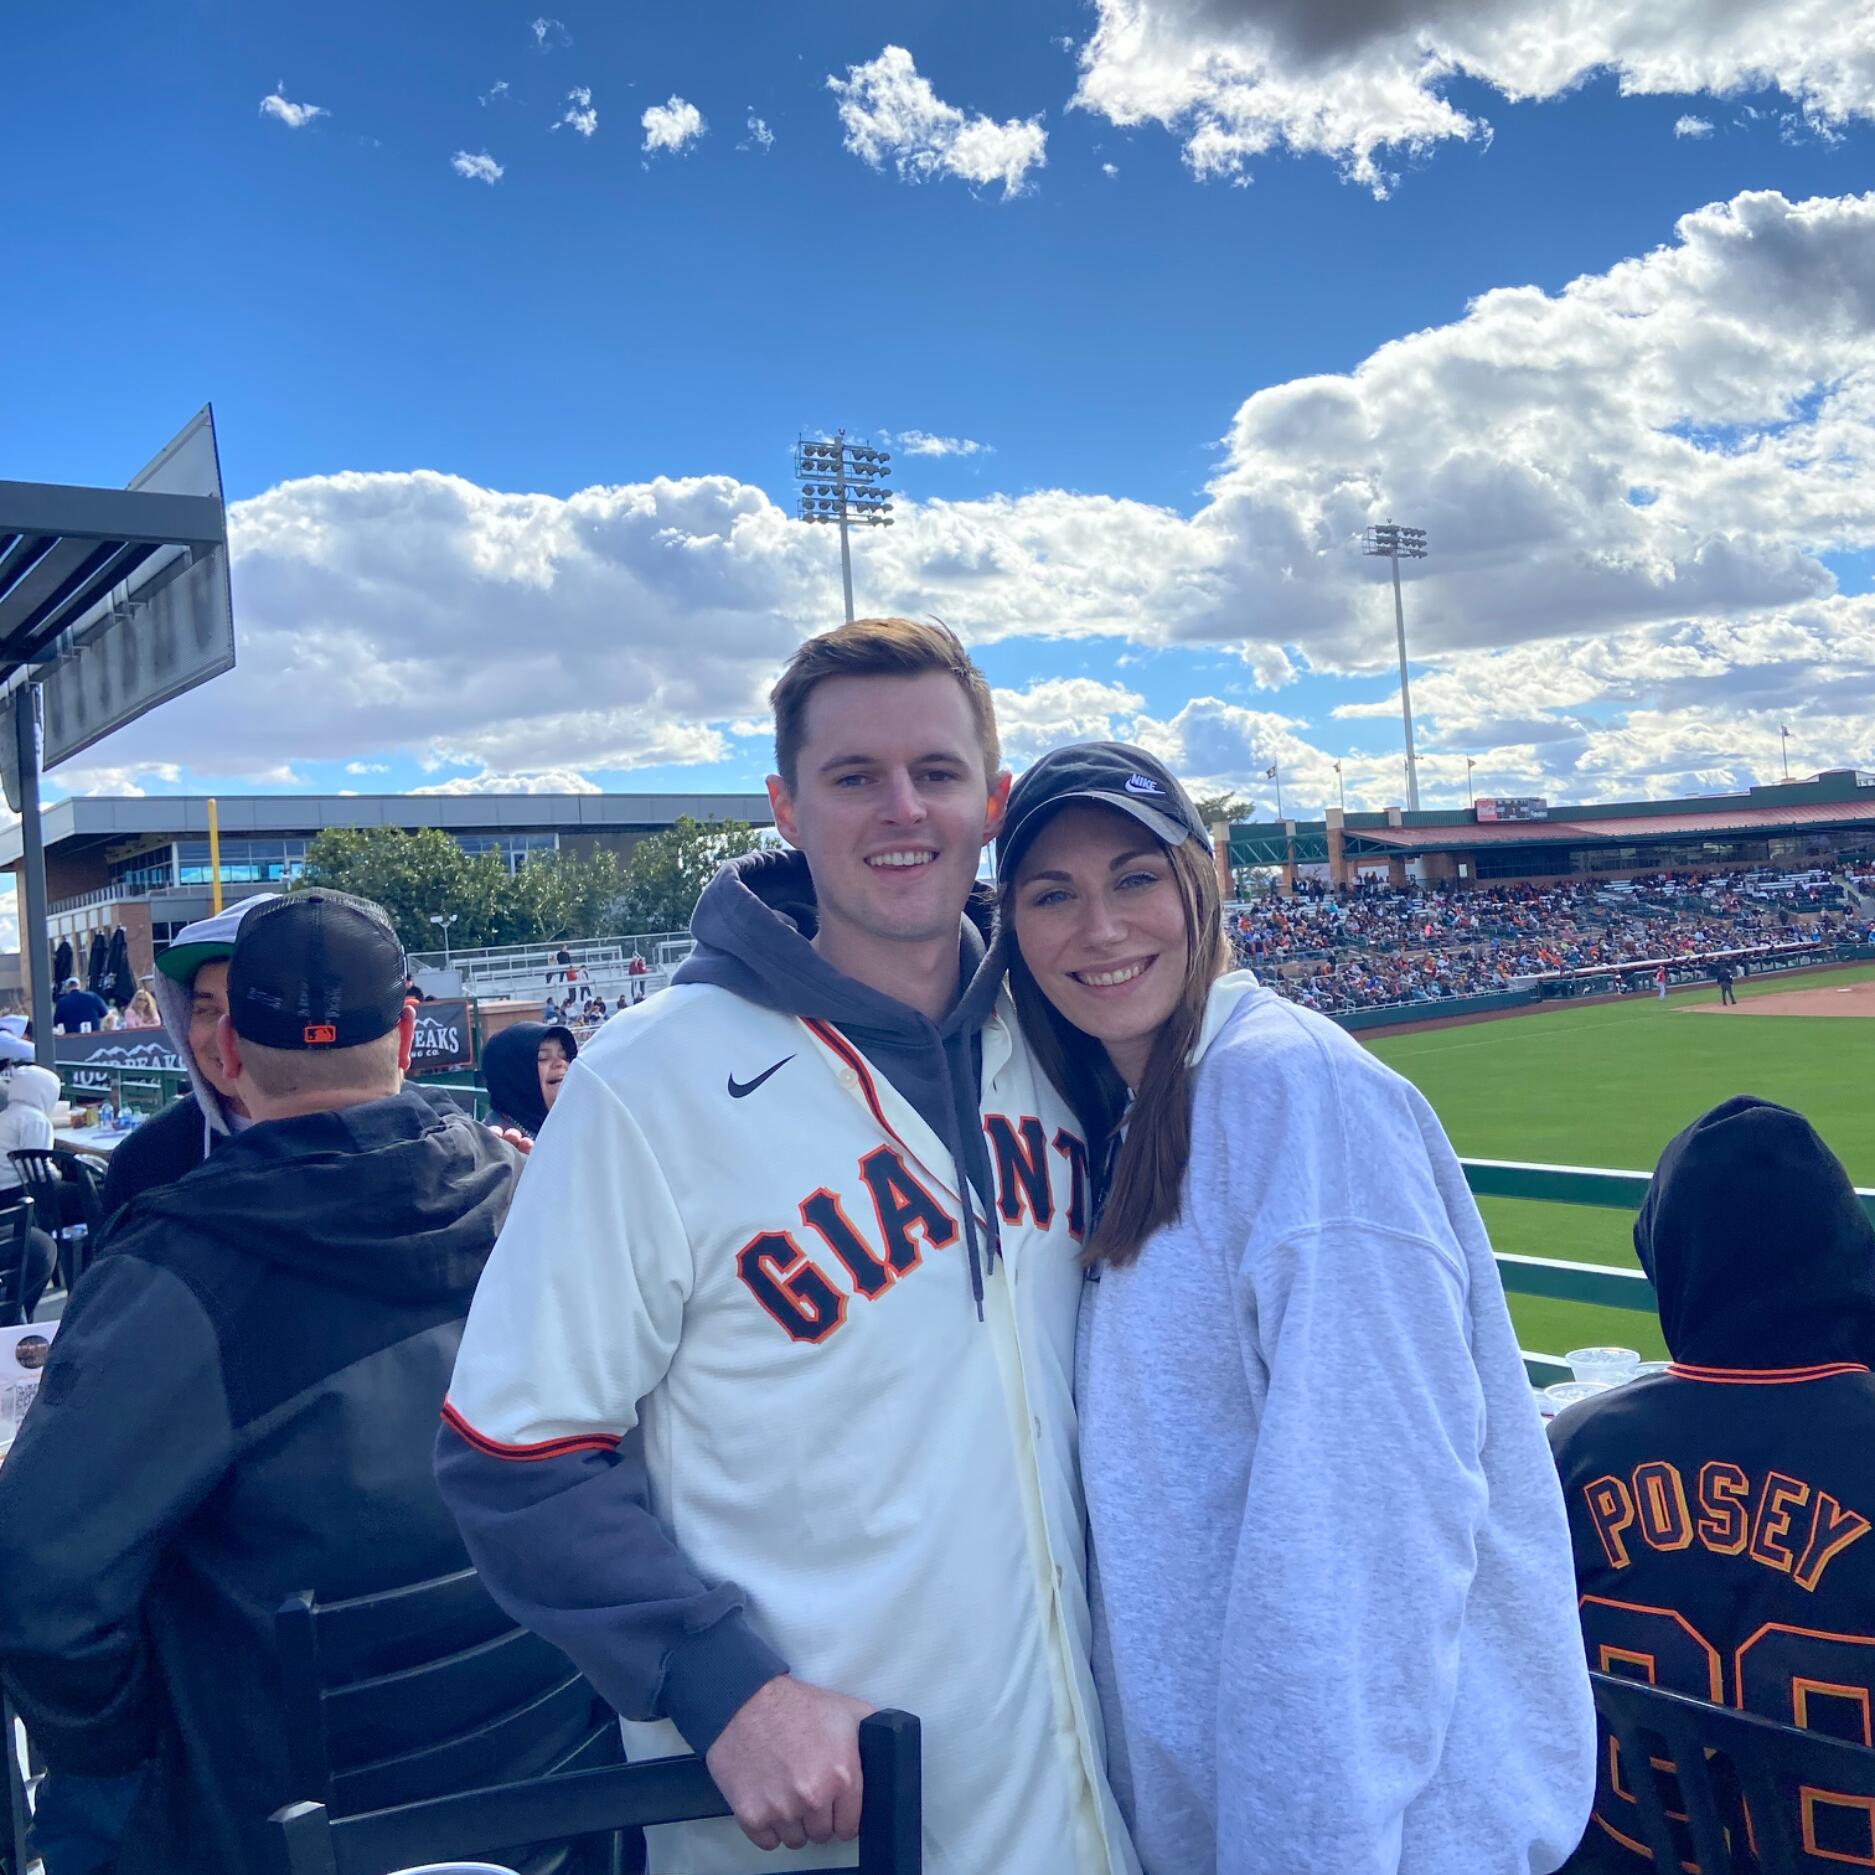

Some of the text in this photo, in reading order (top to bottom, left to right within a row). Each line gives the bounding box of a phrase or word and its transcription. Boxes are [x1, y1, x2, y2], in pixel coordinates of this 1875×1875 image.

[1131, 773, 1158, 790] NIKE
[414, 1026, 460, 1053] EAKS
[1584, 1461, 1872, 1592] POSEY
